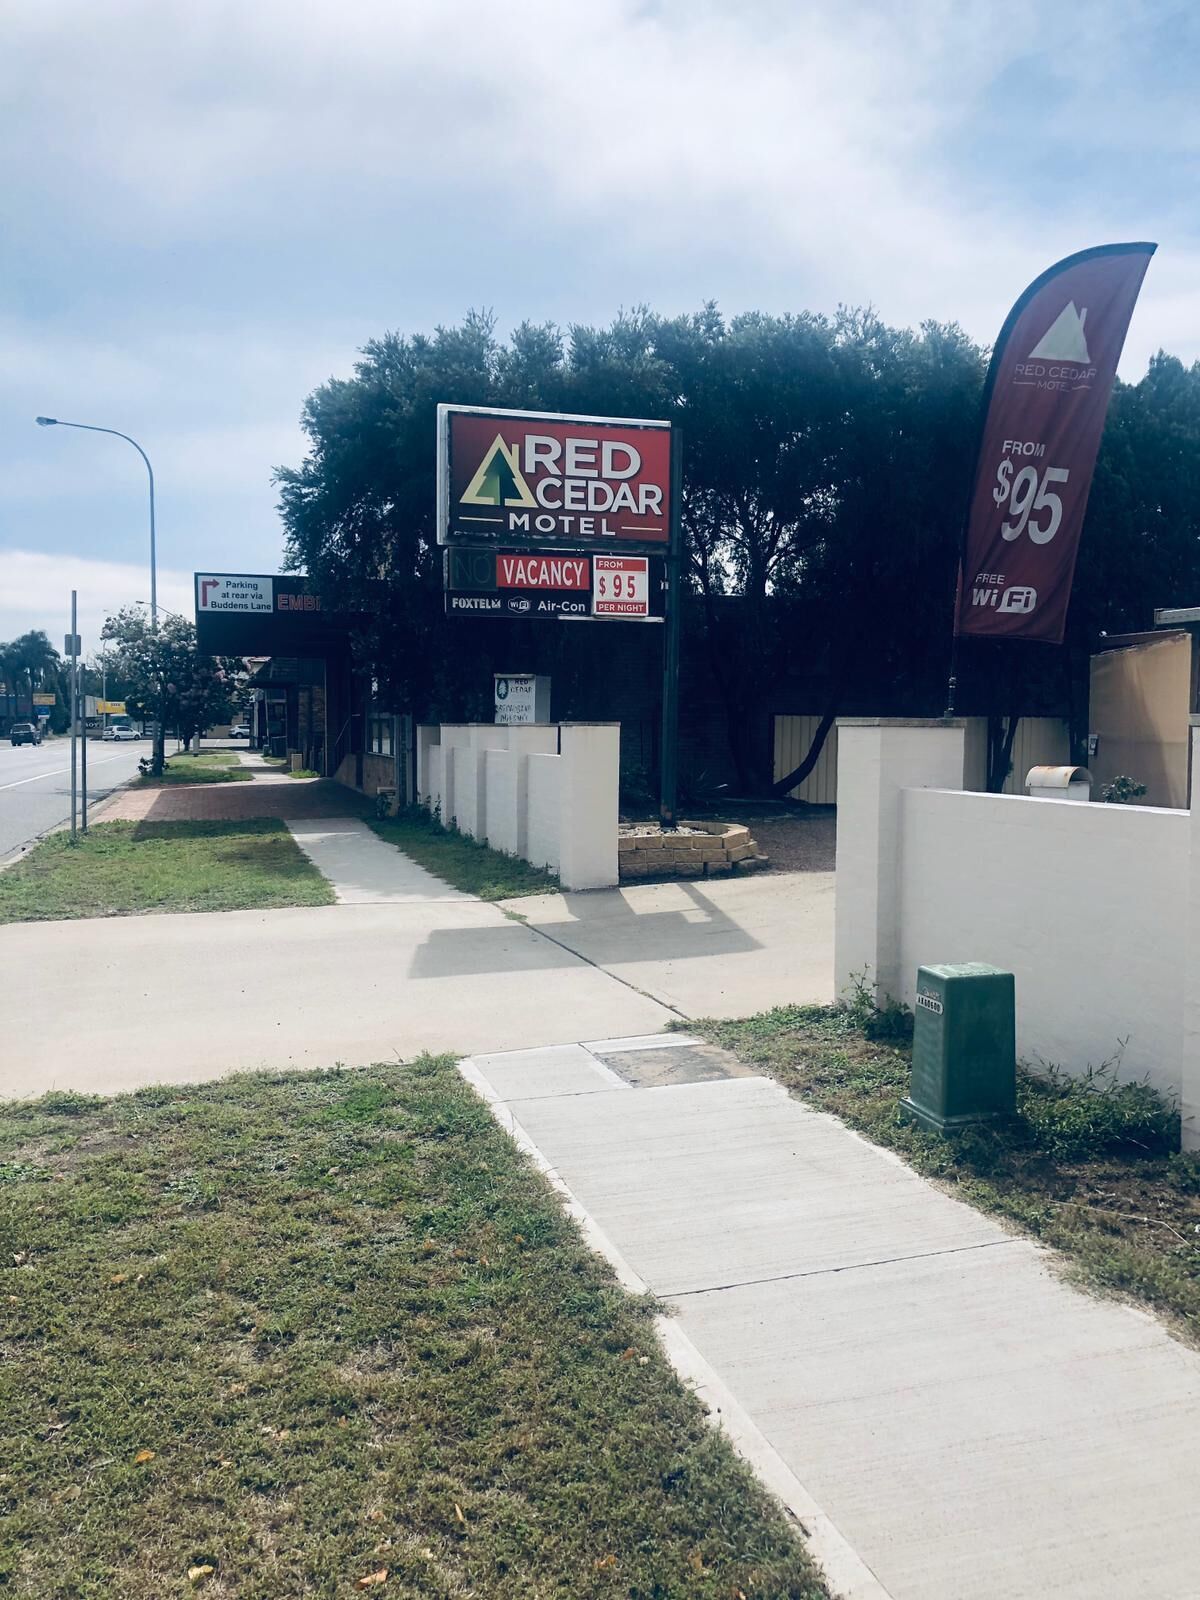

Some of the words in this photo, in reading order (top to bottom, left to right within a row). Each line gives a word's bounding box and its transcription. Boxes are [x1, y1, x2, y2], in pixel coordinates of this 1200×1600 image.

[1014, 363, 1046, 377] RED
[1048, 366, 1097, 381] CEDAR
[1002, 440, 1046, 458] FROM
[524, 434, 642, 480] RED
[535, 477, 664, 516] CEDAR
[993, 457, 1070, 546] $95
[509, 512, 616, 536] MOTEL
[598, 560, 624, 569] FROM
[502, 558, 584, 587] VACANCY
[975, 573, 1005, 585] FREE
[226, 580, 258, 590] Parking
[232, 592, 249, 600] rear
[250, 592, 263, 600] via
[210, 601, 249, 610] Buddens
[251, 601, 272, 610] Lane
[538, 600, 586, 612] Air-Con
[598, 603, 616, 612] PER
[617, 604, 645, 613] NIGHT
